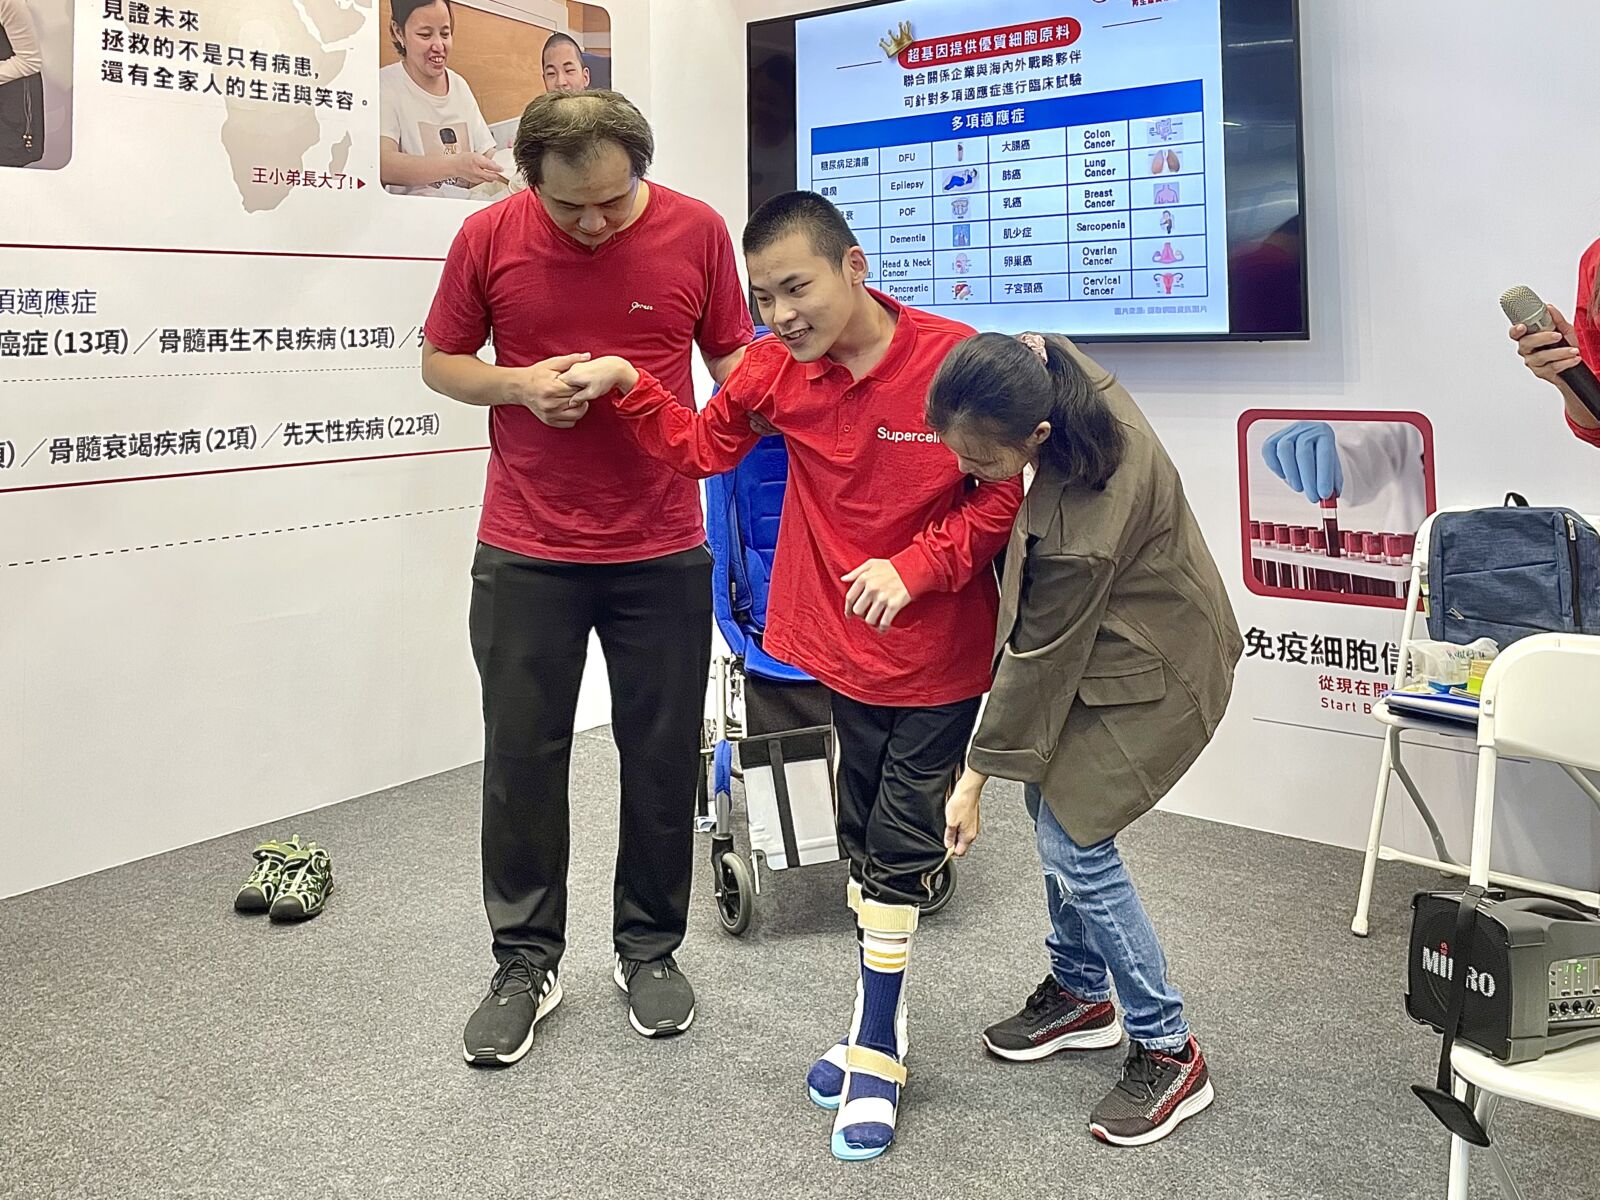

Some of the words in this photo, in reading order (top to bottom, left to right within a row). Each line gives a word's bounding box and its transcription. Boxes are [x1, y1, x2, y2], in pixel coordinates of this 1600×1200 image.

[102, 0, 200, 32] 見證未來
[906, 27, 1071, 64] 超基因提供優質細胞原料
[100, 60, 369, 112] 還有全家人的生活與笑容。
[902, 72, 1083, 109] 可針對多項適應症進行臨床試驗
[950, 107, 1026, 132] 多項適應症
[1084, 130, 1111, 140] Colon
[1001, 139, 1031, 152] 大腸癌
[1084, 139, 1116, 149] Cancer
[898, 152, 916, 163] DFU
[1084, 158, 1106, 169] Lung
[1002, 168, 1022, 181] 肺癌
[1084, 166, 1116, 177] Cancer
[251, 167, 355, 190] 王小弟長大了!
[890, 180, 925, 191] Epilepsy
[1084, 188, 1113, 198] Breast
[1003, 197, 1022, 209] 乳癌
[1085, 198, 1116, 209] Cancer
[899, 207, 916, 216] POF
[1076, 220, 1126, 232] Sarcopenia
[1003, 226, 1032, 239] 肌少症
[890, 233, 926, 244] Dementia
[1082, 246, 1118, 256] Ovarian
[882, 259, 901, 269] Head
[903, 259, 910, 268] &
[912, 258, 932, 268] Neck
[1003, 254, 1033, 268] 卵巢癌
[1082, 256, 1114, 266] Cancer
[882, 269, 908, 278] Cancer
[1083, 275, 1122, 286] Cervical
[889, 283, 929, 293] Pancreatic
[1004, 282, 1044, 295] 子宮頸癌
[1083, 286, 1115, 296] Cancer
[1321, 697, 1356, 713] Start
